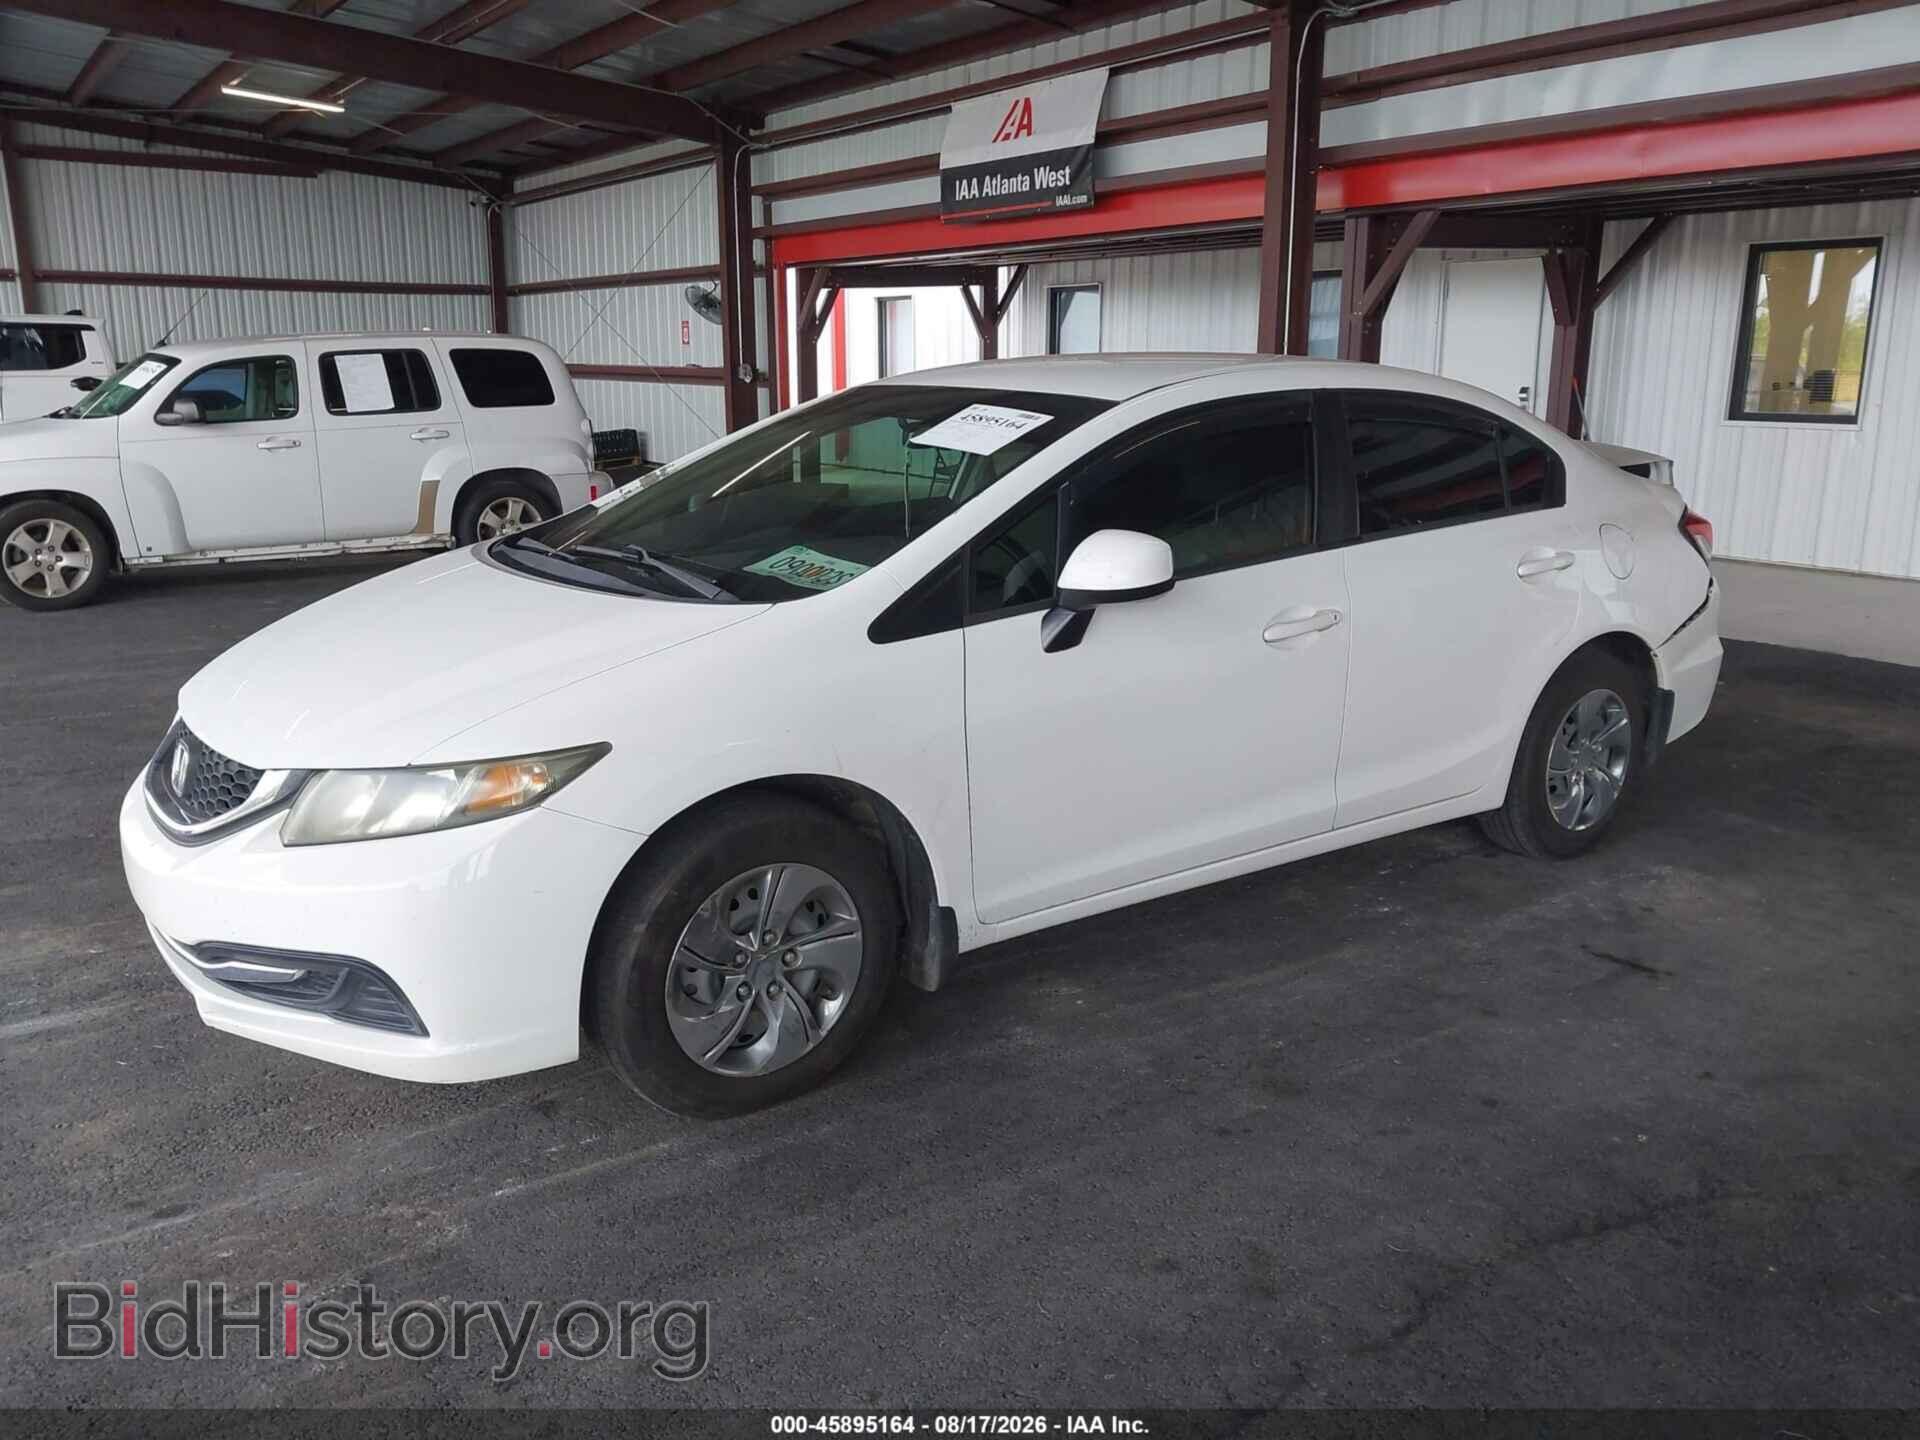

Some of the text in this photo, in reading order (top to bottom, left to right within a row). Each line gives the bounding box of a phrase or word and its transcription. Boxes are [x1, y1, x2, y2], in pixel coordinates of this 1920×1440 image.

[955, 165, 1071, 201] IAA Atlanta West
